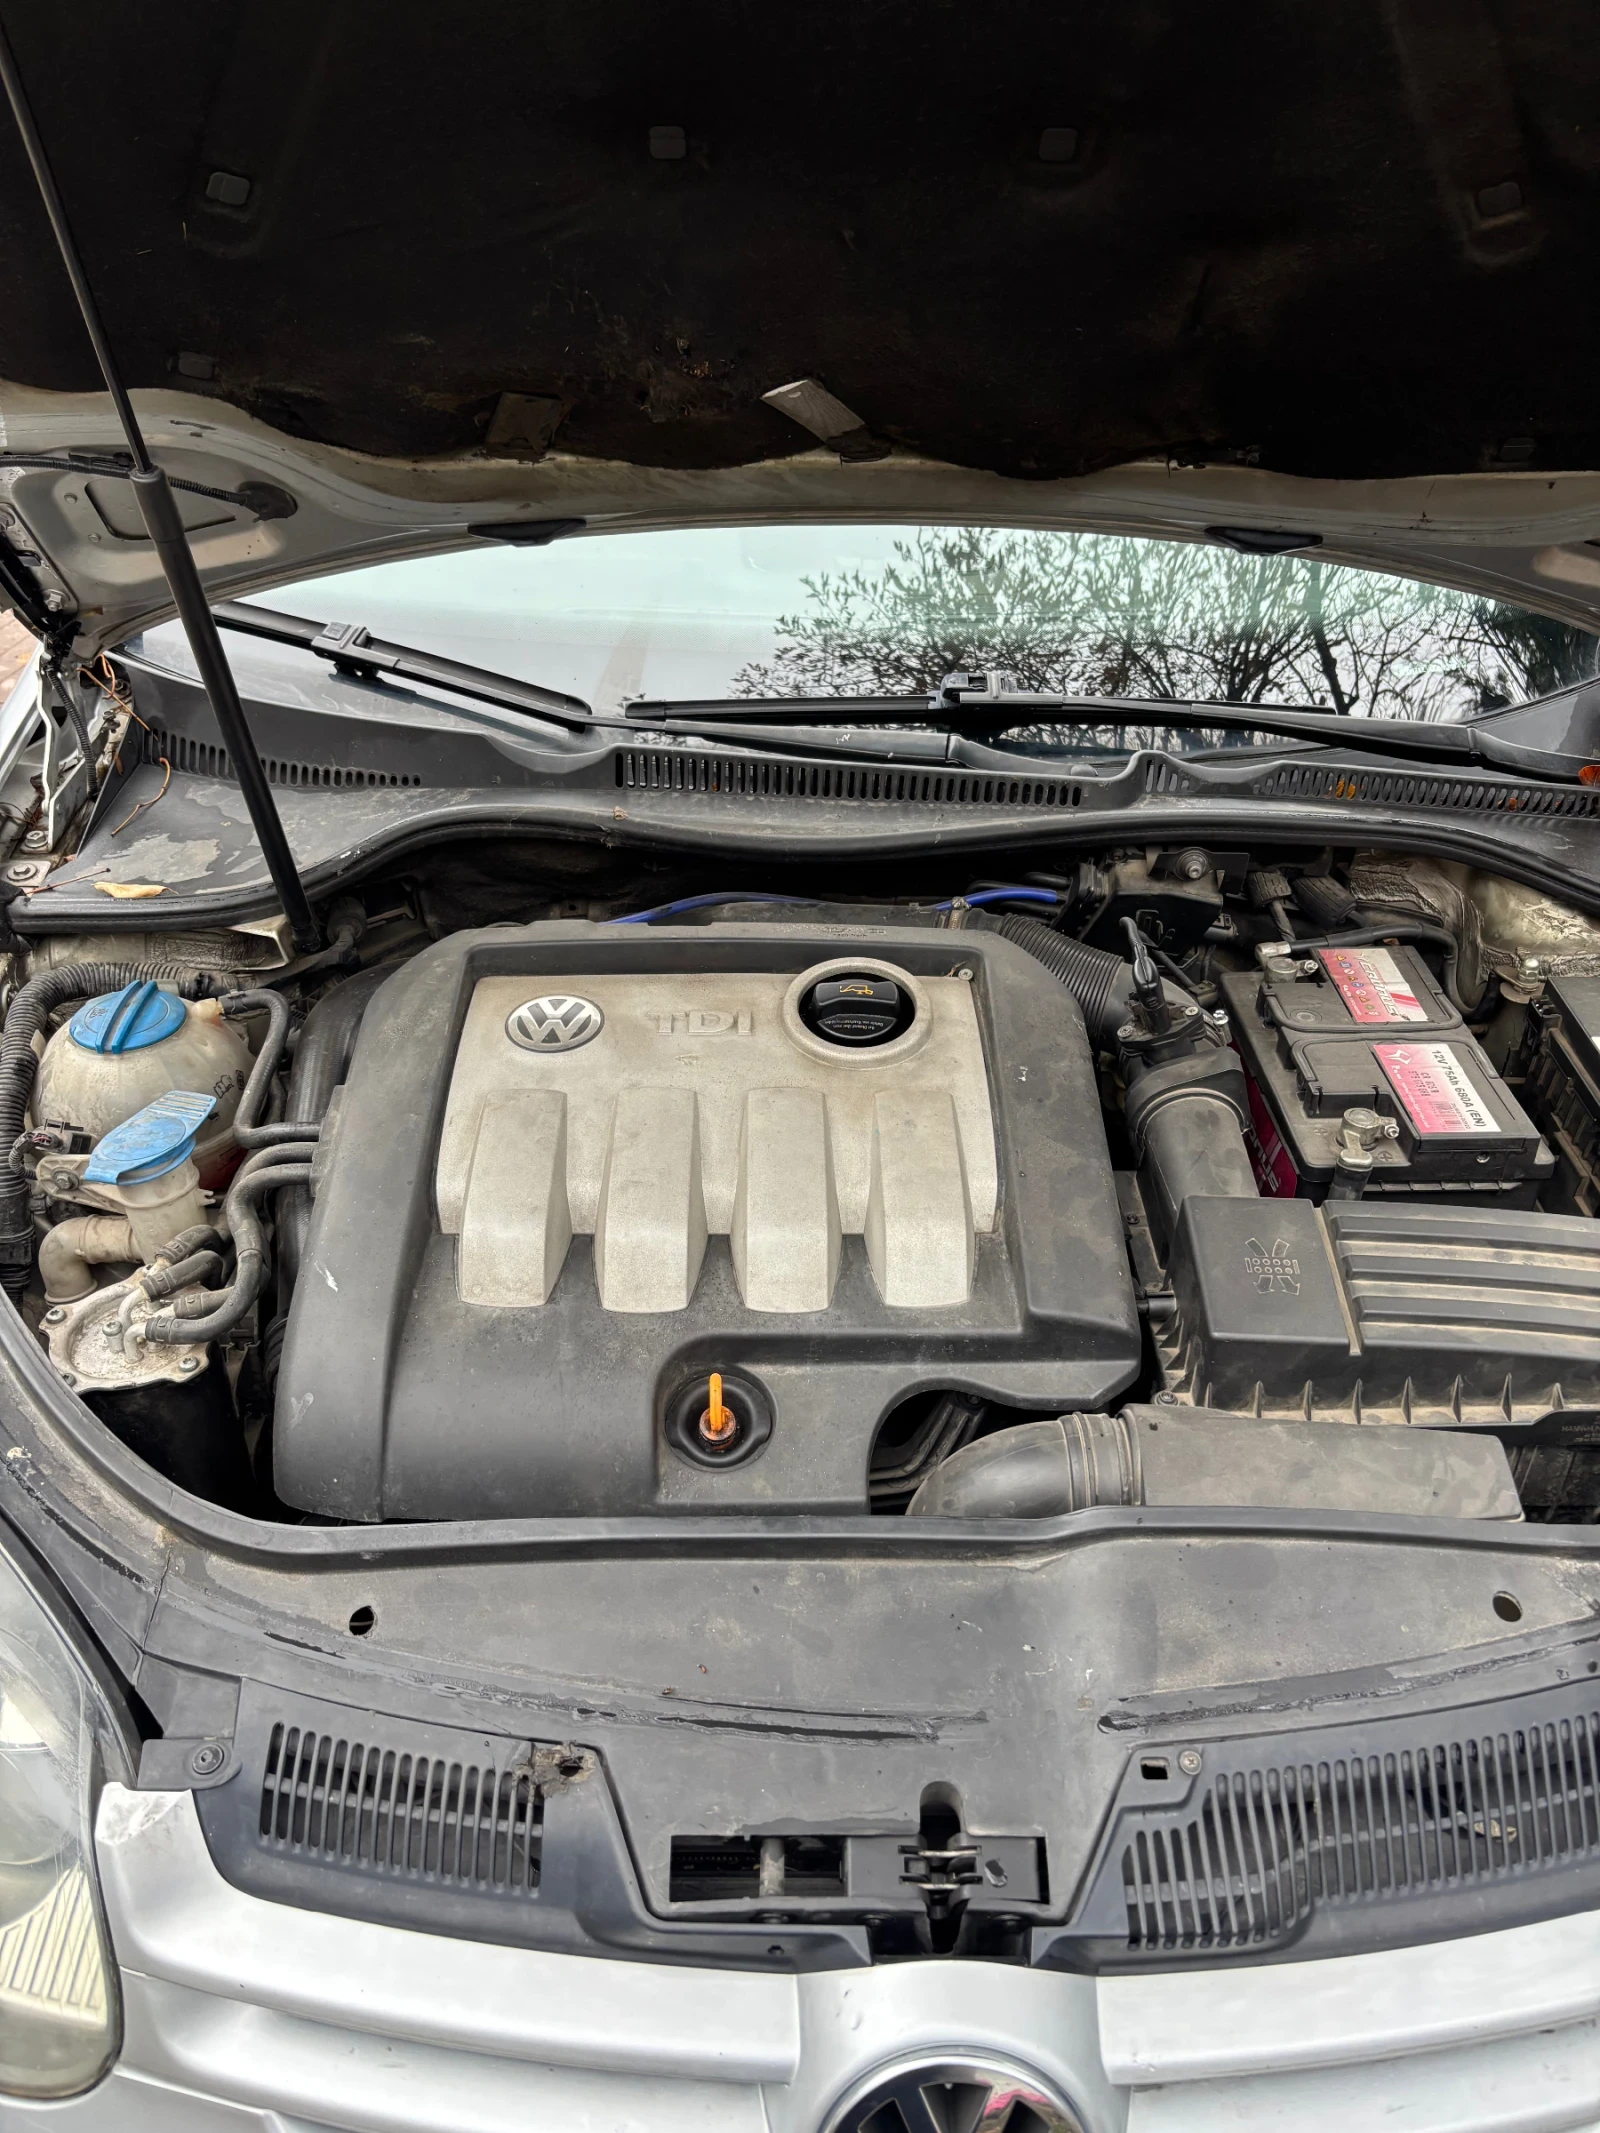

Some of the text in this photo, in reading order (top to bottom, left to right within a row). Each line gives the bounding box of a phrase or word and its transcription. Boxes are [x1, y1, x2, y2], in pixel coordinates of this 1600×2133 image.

[507, 995, 604, 1053] VW
[648, 1009, 753, 1036] TDI
[1432, 1050, 1448, 1065] 12V
[1441, 1065, 1459, 1086] 75Ah
[1454, 1087, 1474, 1108] 680A
[1466, 1109, 1487, 1127] (EN)
